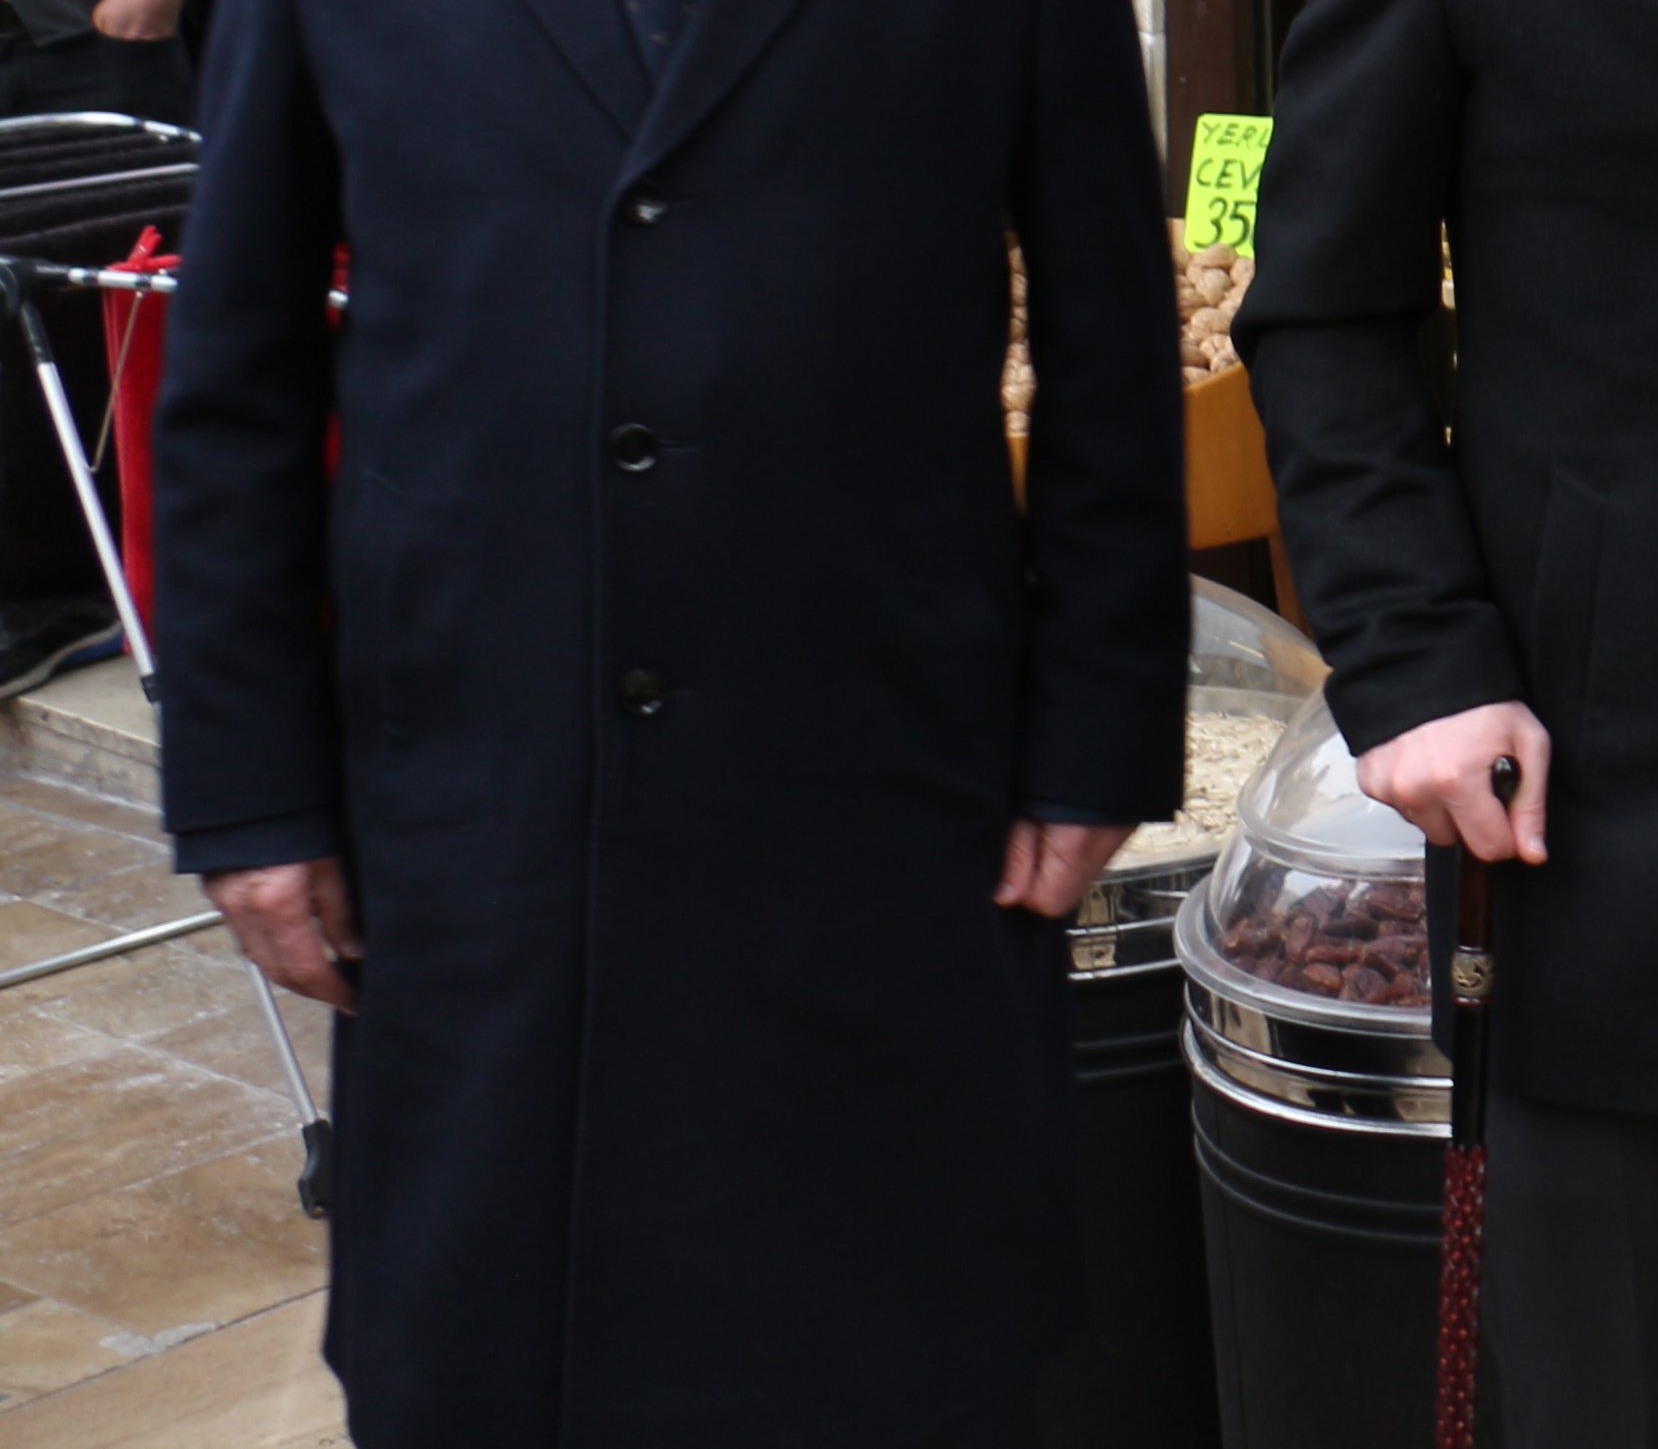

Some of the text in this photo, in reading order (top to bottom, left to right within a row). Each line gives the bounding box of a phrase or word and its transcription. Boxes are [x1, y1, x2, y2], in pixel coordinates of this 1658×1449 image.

[1201, 121, 1270, 149] YERL
[1196, 157, 1261, 190] CEV
[1193, 196, 1257, 249] 35
